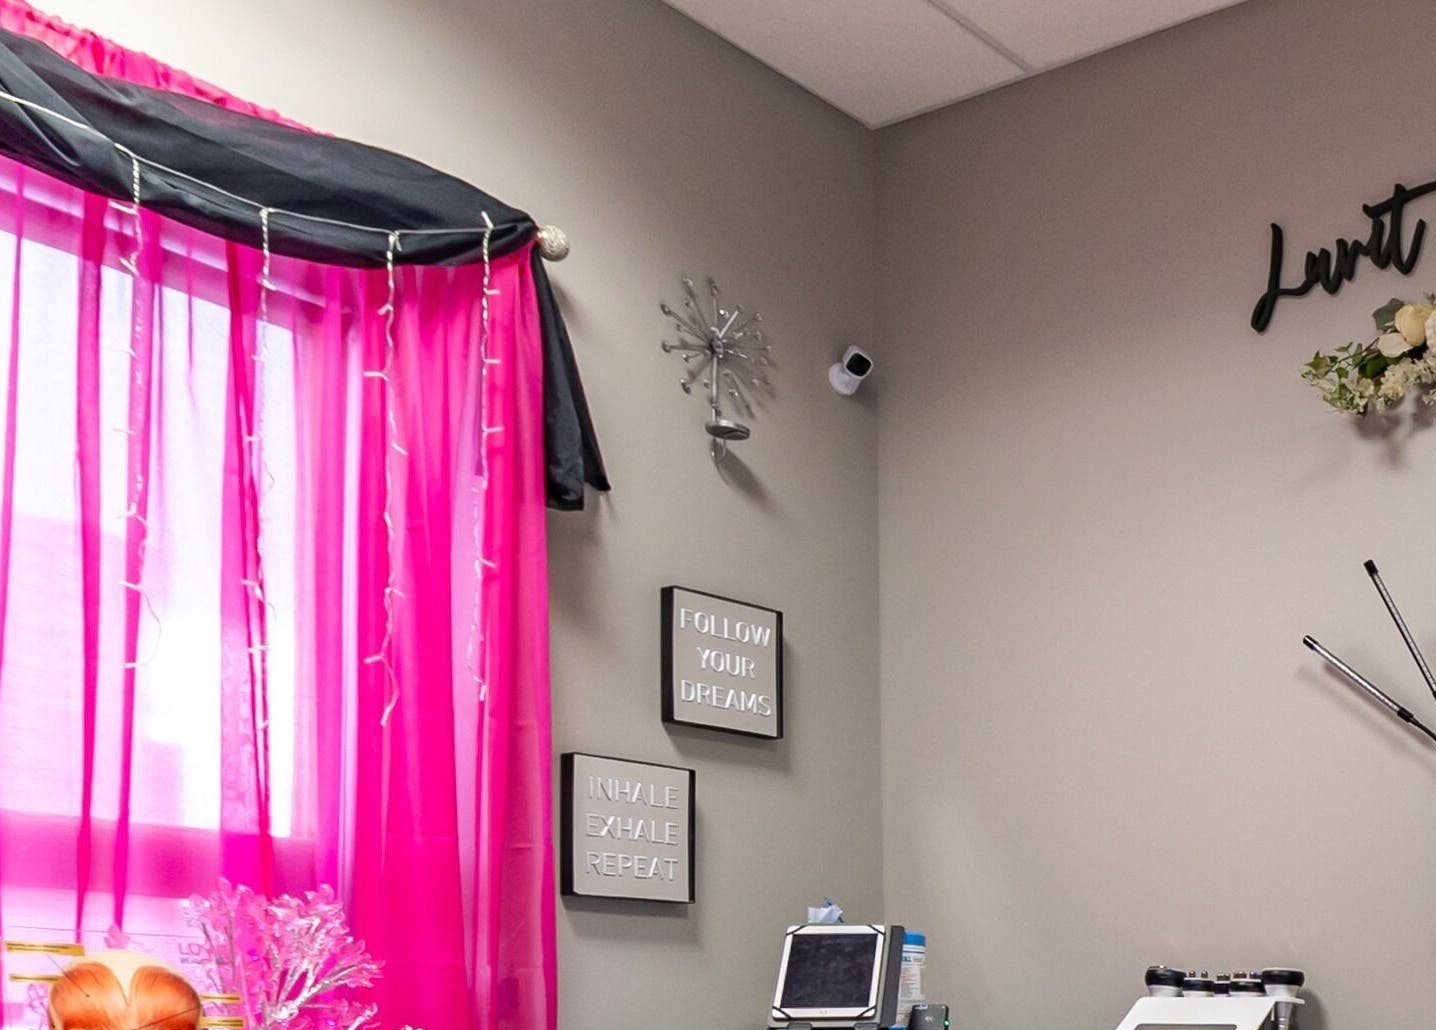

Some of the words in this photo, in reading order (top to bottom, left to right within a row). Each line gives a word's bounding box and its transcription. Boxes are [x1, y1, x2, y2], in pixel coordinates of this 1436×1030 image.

[679, 607, 771, 648] FOLLOW
[696, 647, 756, 679] YOUR
[680, 679, 772, 717] DREAMS
[588, 775, 680, 809] INHALE
[584, 813, 679, 846] EXHALE
[585, 851, 679, 882] REPEAT
